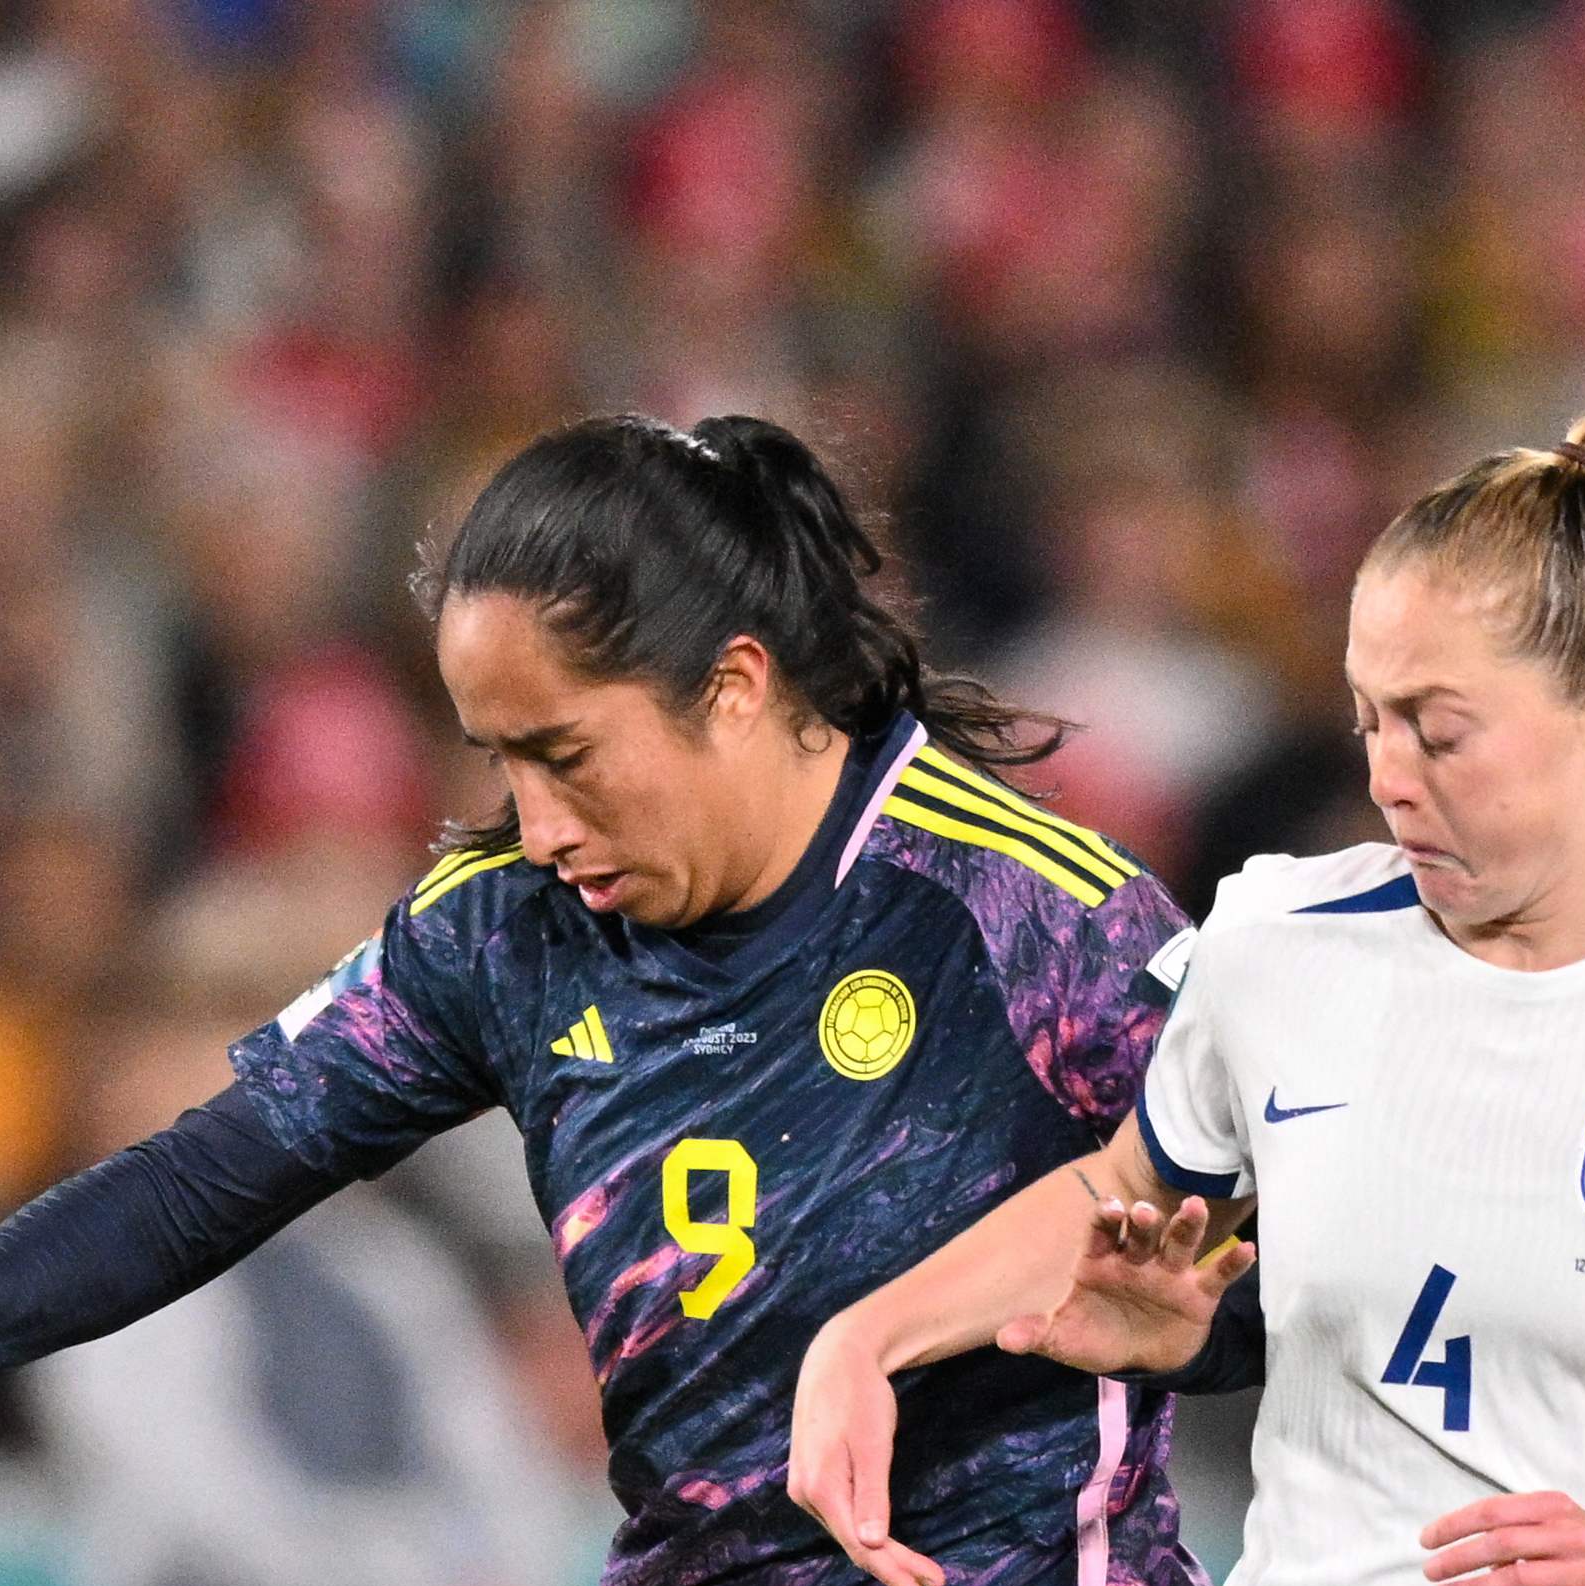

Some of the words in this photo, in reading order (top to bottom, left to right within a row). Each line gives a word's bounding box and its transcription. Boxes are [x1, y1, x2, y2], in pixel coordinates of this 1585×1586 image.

[693, 1043, 734, 1055] SYDNEY
[729, 1032, 758, 1044] 2023
[662, 1138, 758, 1320] 9
[1380, 1263, 1471, 1432] 4
